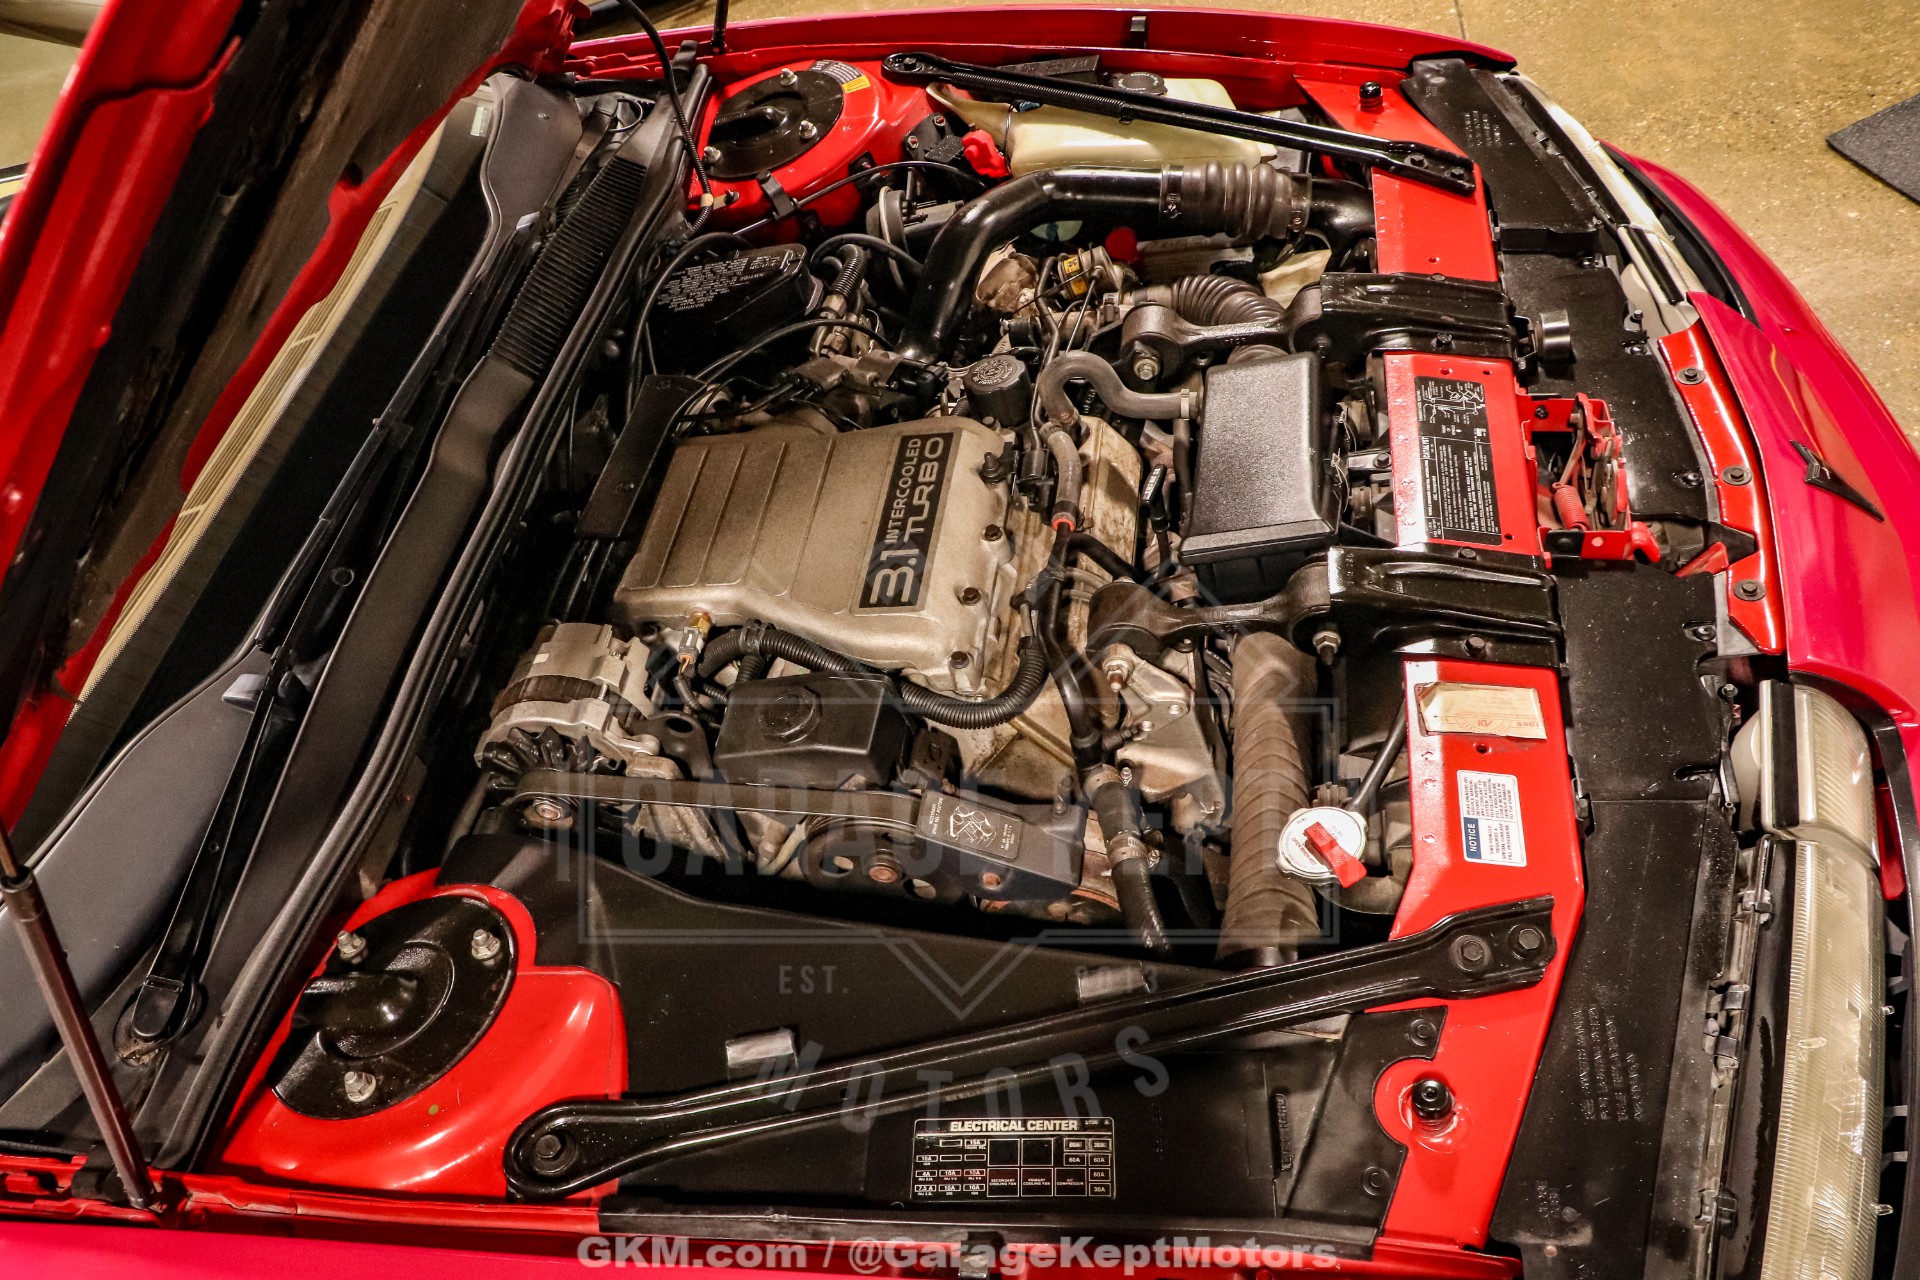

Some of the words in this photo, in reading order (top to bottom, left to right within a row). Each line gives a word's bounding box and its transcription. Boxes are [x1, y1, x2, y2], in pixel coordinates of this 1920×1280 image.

[869, 548, 920, 604] 3.1
[903, 436, 945, 543] TURBO
[884, 438, 922, 545] INTERCOOLED
[1468, 823, 1478, 852] NOTICE
[950, 1120, 1025, 1132] ELECTRICAL
[1027, 1120, 1078, 1131] CENTER
